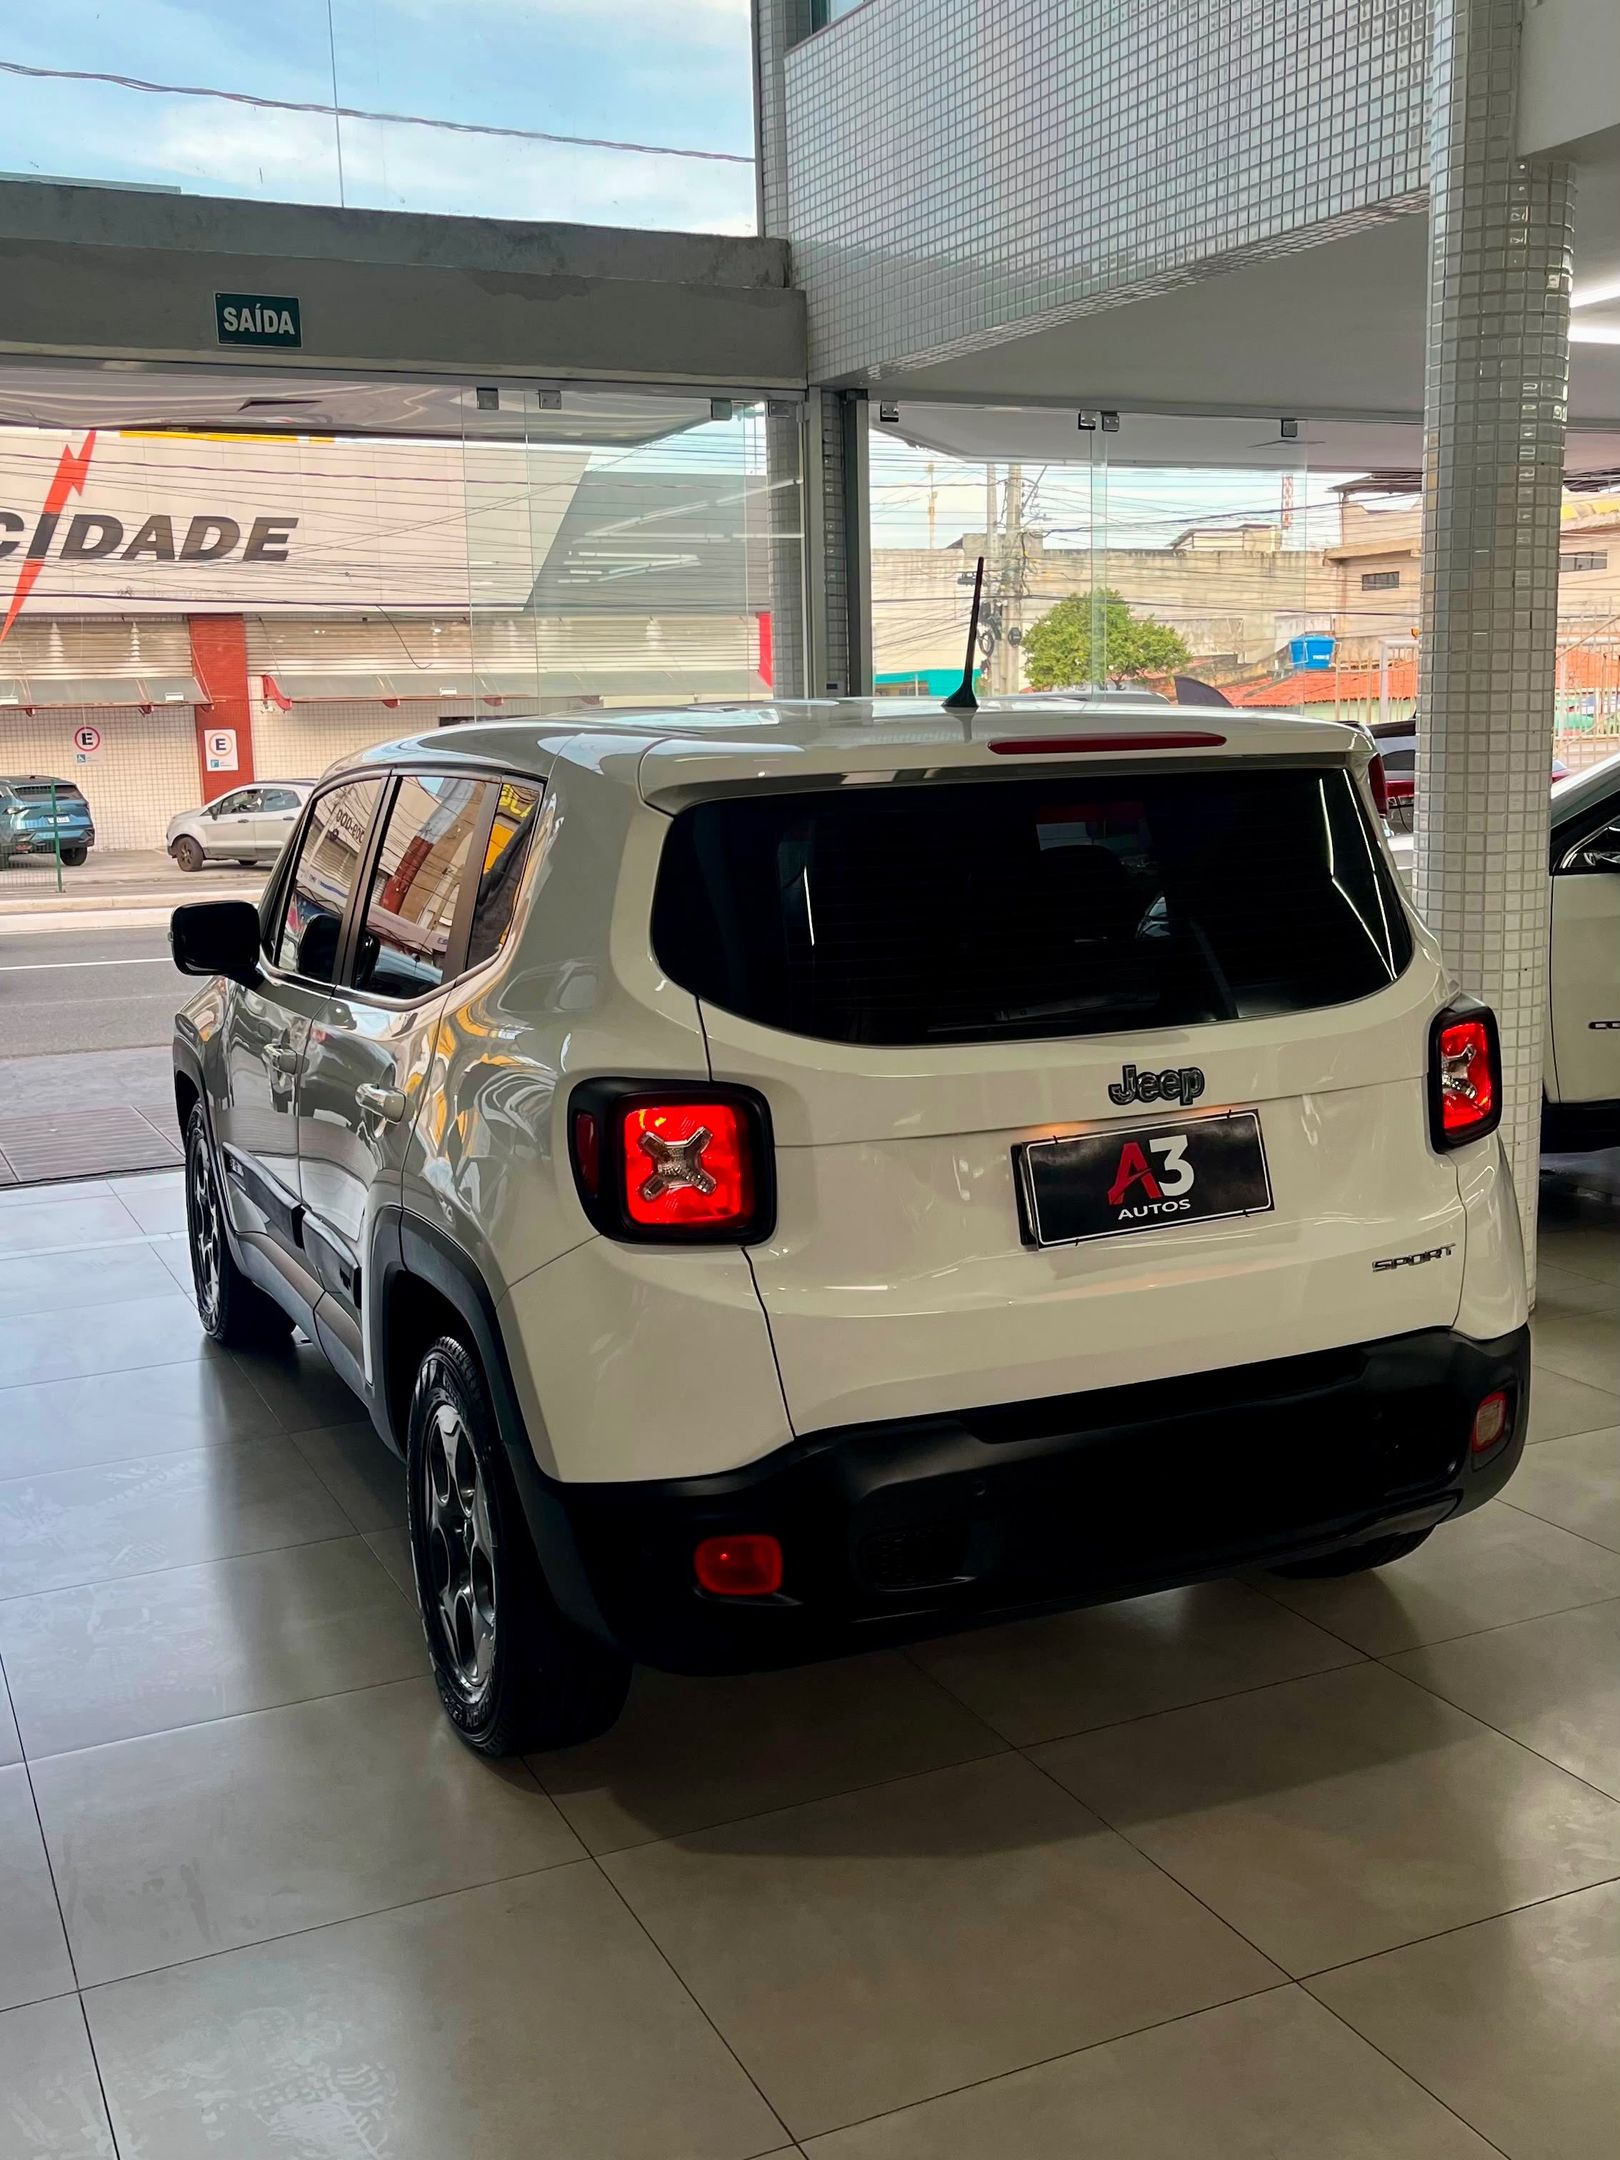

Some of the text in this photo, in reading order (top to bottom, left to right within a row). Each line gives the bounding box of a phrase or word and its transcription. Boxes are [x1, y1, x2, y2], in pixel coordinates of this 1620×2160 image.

[223, 303, 296, 335] SAÍDA
[81, 732, 94, 746] E
[215, 737, 227, 751] E
[1108, 1064, 1205, 1106] Jeep
[1107, 1134, 1195, 1206] A3
[1117, 1198, 1192, 1221] AUTOS
[1371, 1242, 1456, 1273] SPORT
